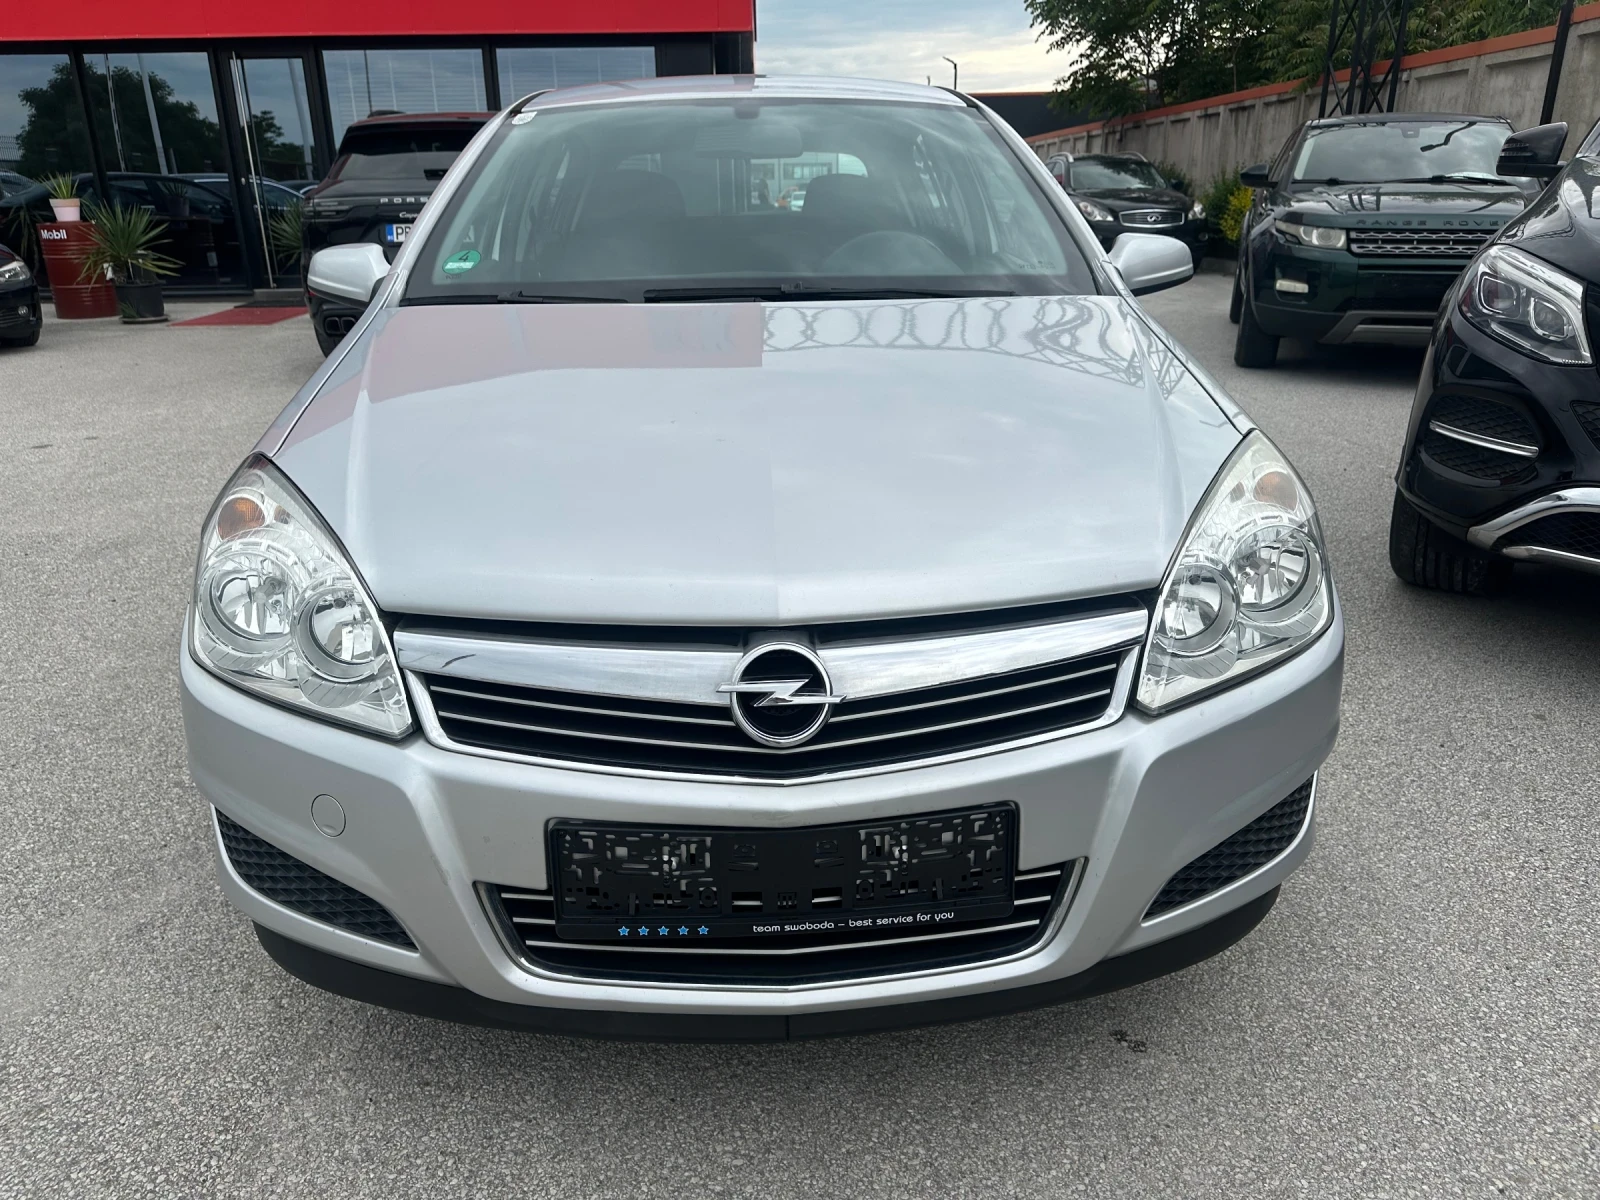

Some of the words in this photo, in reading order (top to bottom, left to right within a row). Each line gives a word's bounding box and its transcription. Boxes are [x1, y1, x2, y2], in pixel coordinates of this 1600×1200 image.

[1356, 219, 1428, 227] RANGE
[41, 229, 67, 239] Mobil
[458, 250, 471, 262] 4
[753, 925, 781, 933] team
[784, 921, 834, 932] swoboda
[848, 918, 873, 927] best
[876, 915, 914, 925] service
[916, 912, 931, 922] for
[934, 911, 954, 922] you
